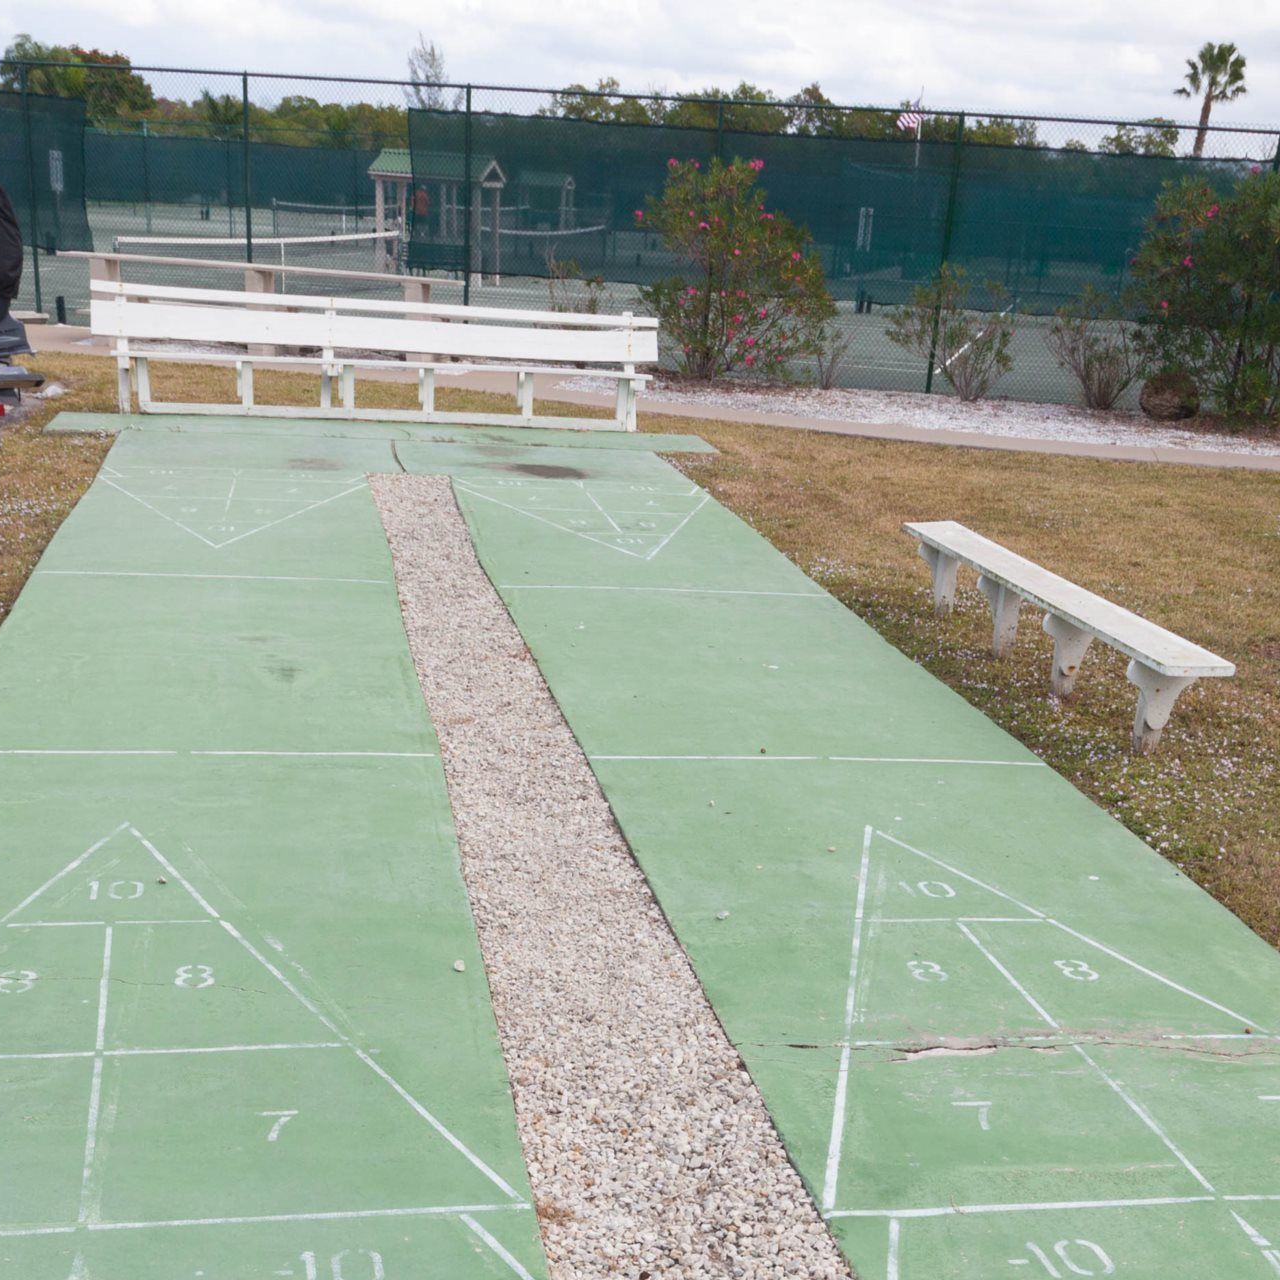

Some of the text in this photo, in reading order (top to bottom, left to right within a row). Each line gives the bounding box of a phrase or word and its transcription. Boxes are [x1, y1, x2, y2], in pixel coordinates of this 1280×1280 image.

[89, 880, 144, 900] 10
[898, 880, 956, 898] 10
[174, 965, 215, 988] 8
[906, 960, 948, 982] 8
[1053, 959, 1100, 981] 8
[256, 1109, 299, 1142] 7
[951, 1100, 993, 1130] 7
[1008, 1238, 1115, 1279] -10
